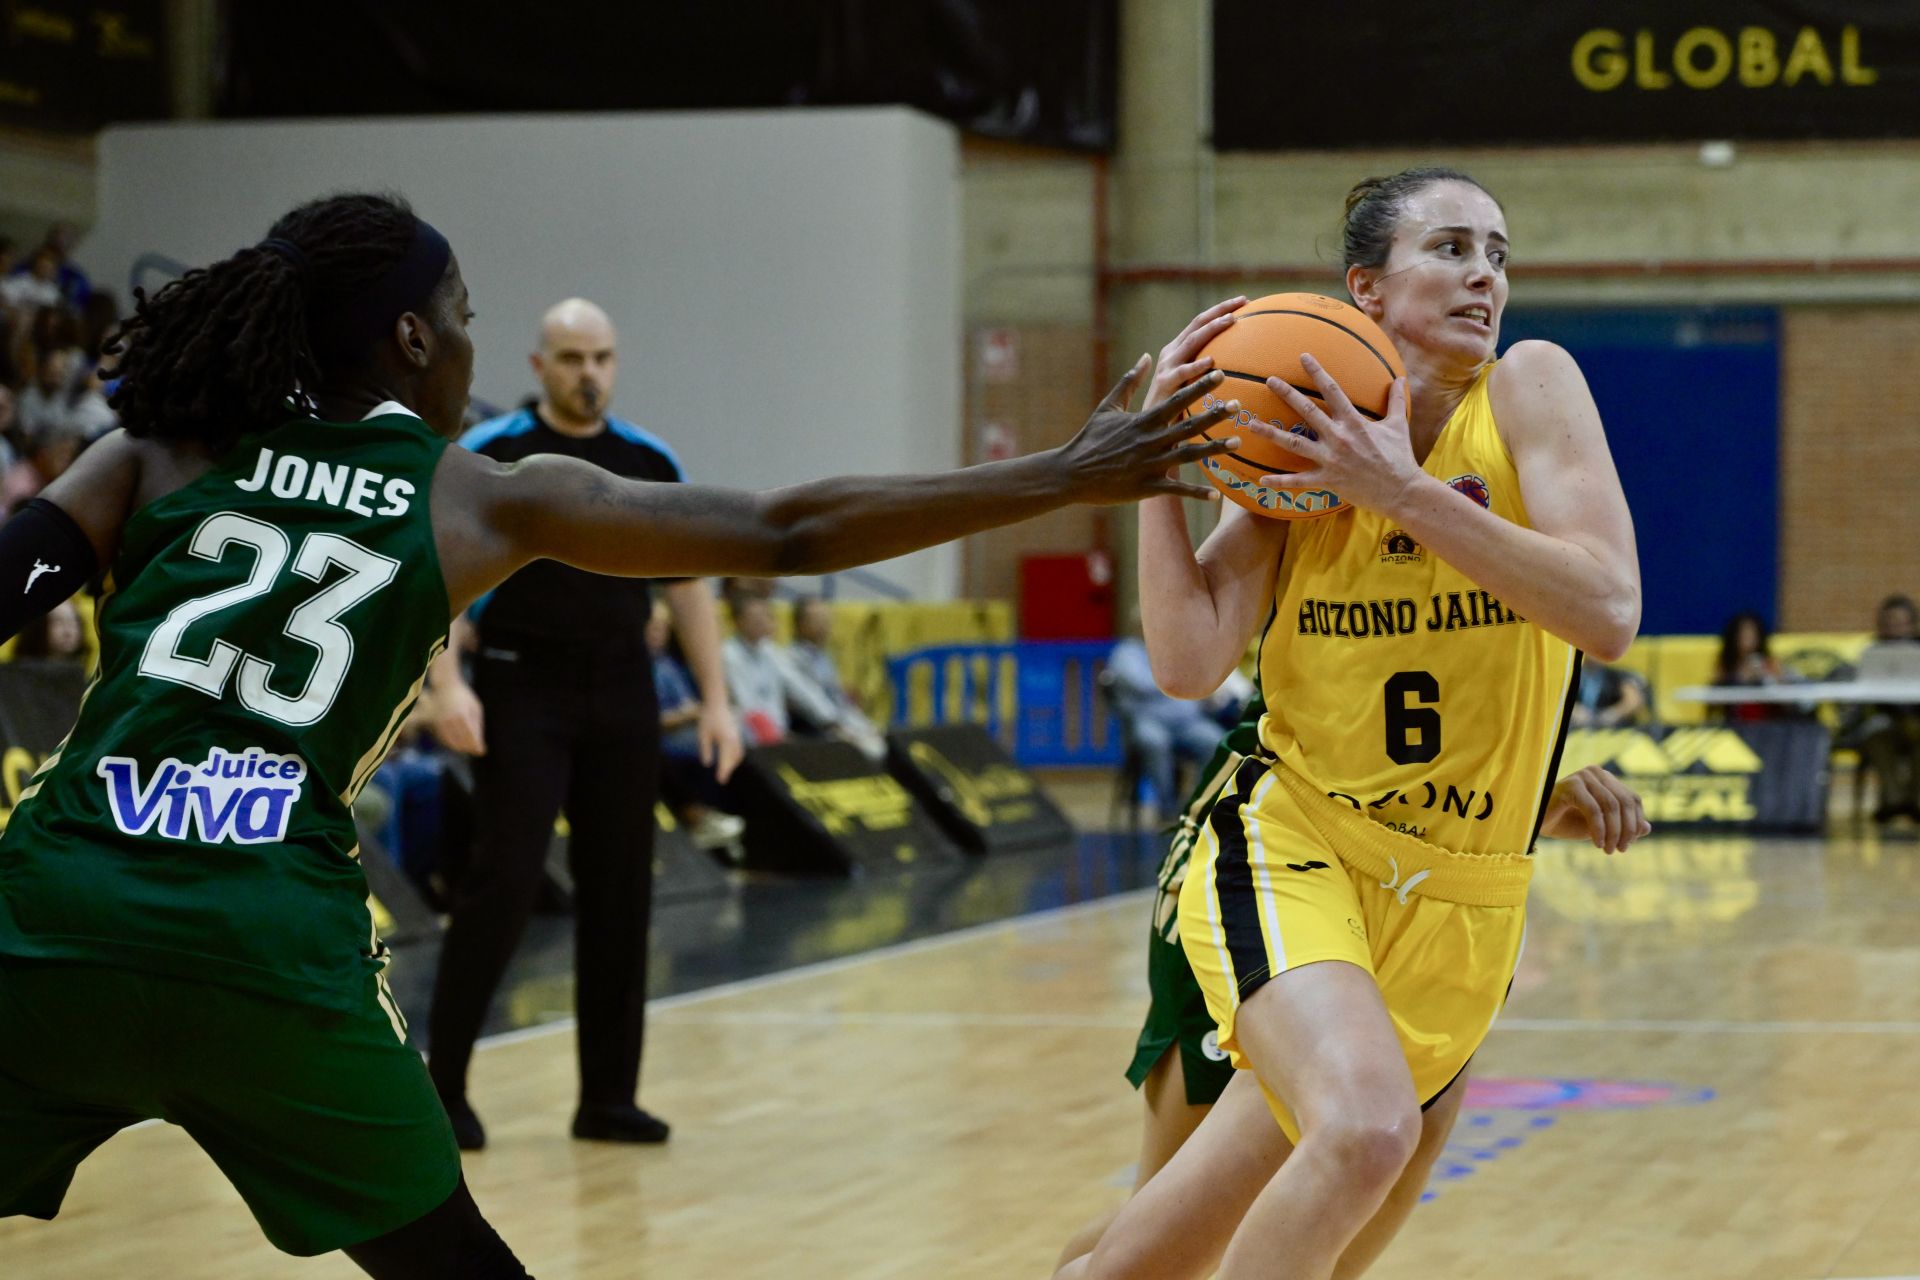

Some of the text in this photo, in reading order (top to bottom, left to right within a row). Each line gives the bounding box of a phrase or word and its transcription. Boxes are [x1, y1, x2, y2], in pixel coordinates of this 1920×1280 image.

[1571, 25, 1879, 91] GLOBAL
[234, 448, 416, 518] JONES
[137, 511, 402, 727] 23
[1298, 589, 1529, 639] HOZONO JAIR
[1384, 671, 1441, 765] 6
[202, 753, 301, 780] Juice
[105, 763, 294, 841] Viva
